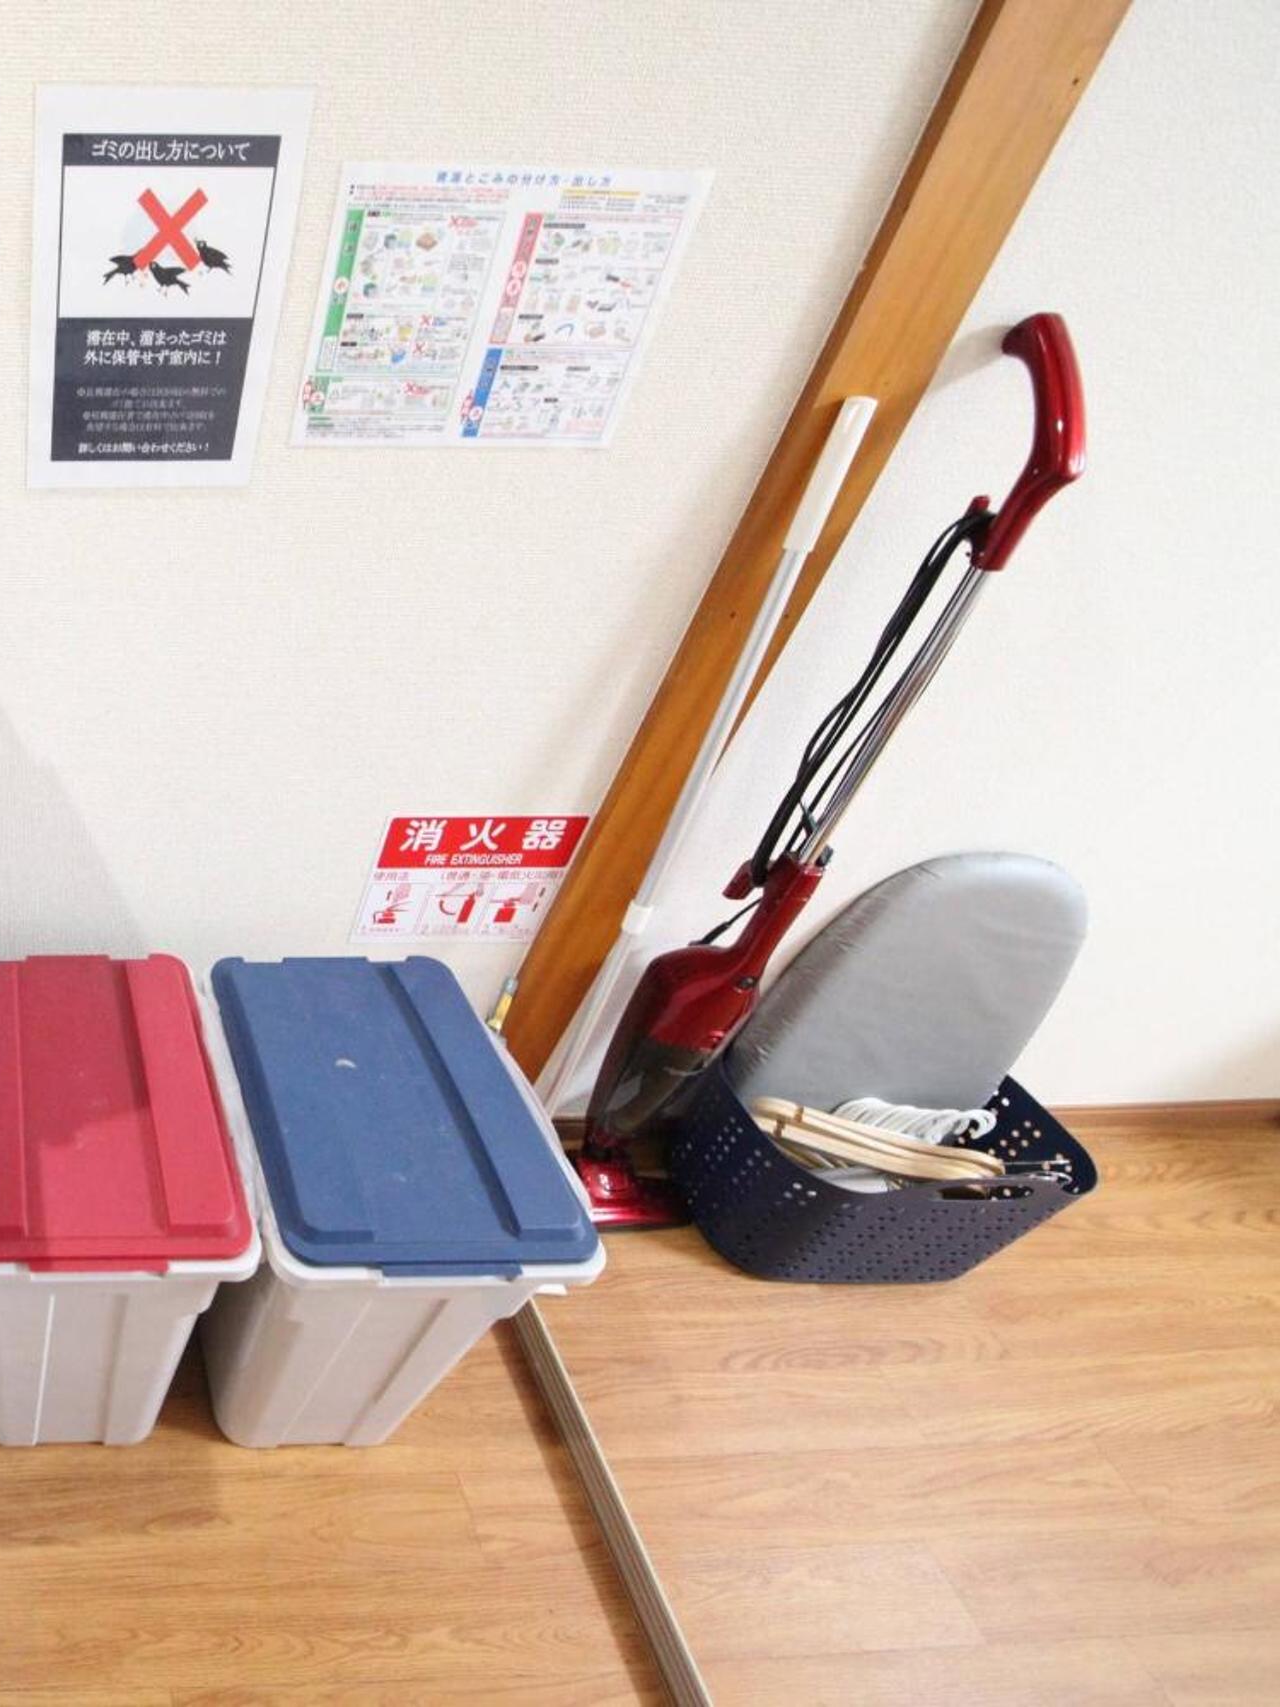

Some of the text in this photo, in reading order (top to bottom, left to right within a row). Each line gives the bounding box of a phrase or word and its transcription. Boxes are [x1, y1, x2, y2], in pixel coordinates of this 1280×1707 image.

[91, 139, 251, 161] ゴミの出し方について
[399, 818, 568, 851] 消火器
[424, 852, 523, 866] FIRE EXTINGUISHER
